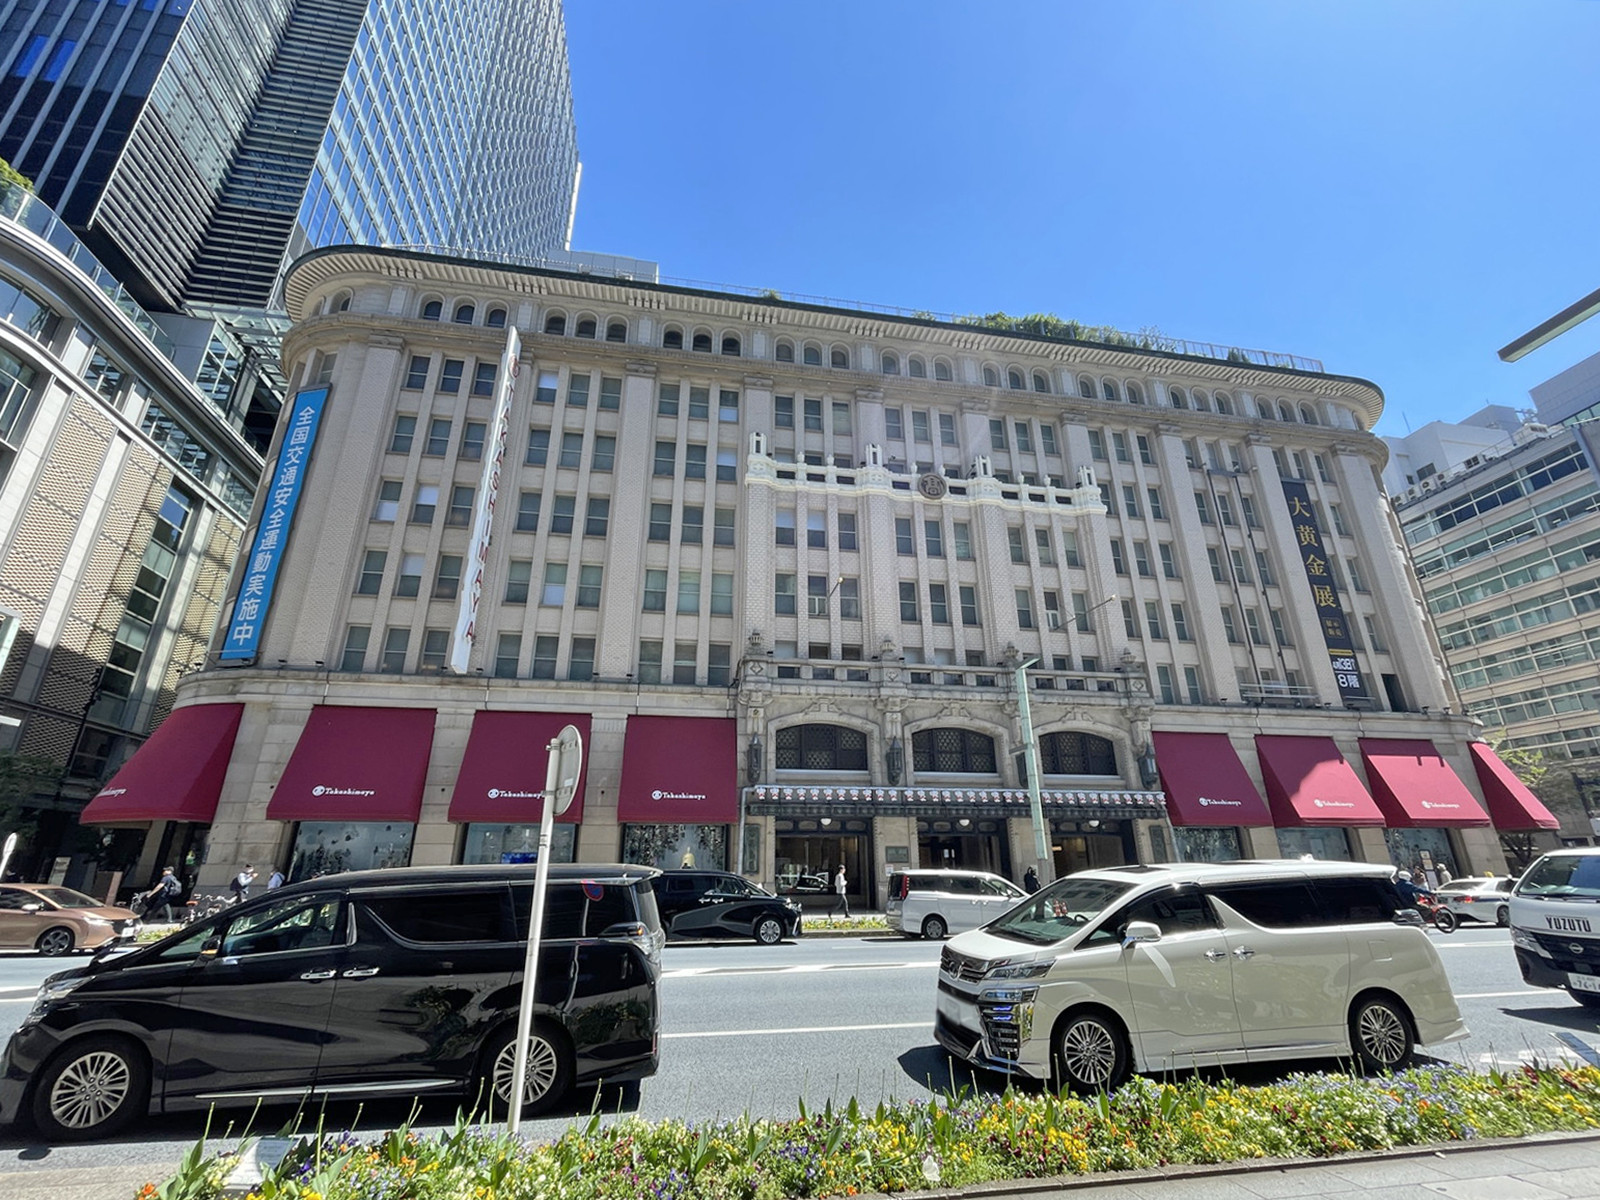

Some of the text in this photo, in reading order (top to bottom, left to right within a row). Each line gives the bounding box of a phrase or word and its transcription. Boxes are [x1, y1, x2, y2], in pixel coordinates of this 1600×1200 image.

[233, 406, 315, 646] 全国交通安全運動実施中
[465, 383, 514, 641] TAKASHIMAYA
[1289, 497, 1337, 608] 大黄金展
[325, 788, 375, 797] Takashimaya
[662, 792, 706, 800] Takashimaya
[1545, 917, 1592, 932] YUZUTU
